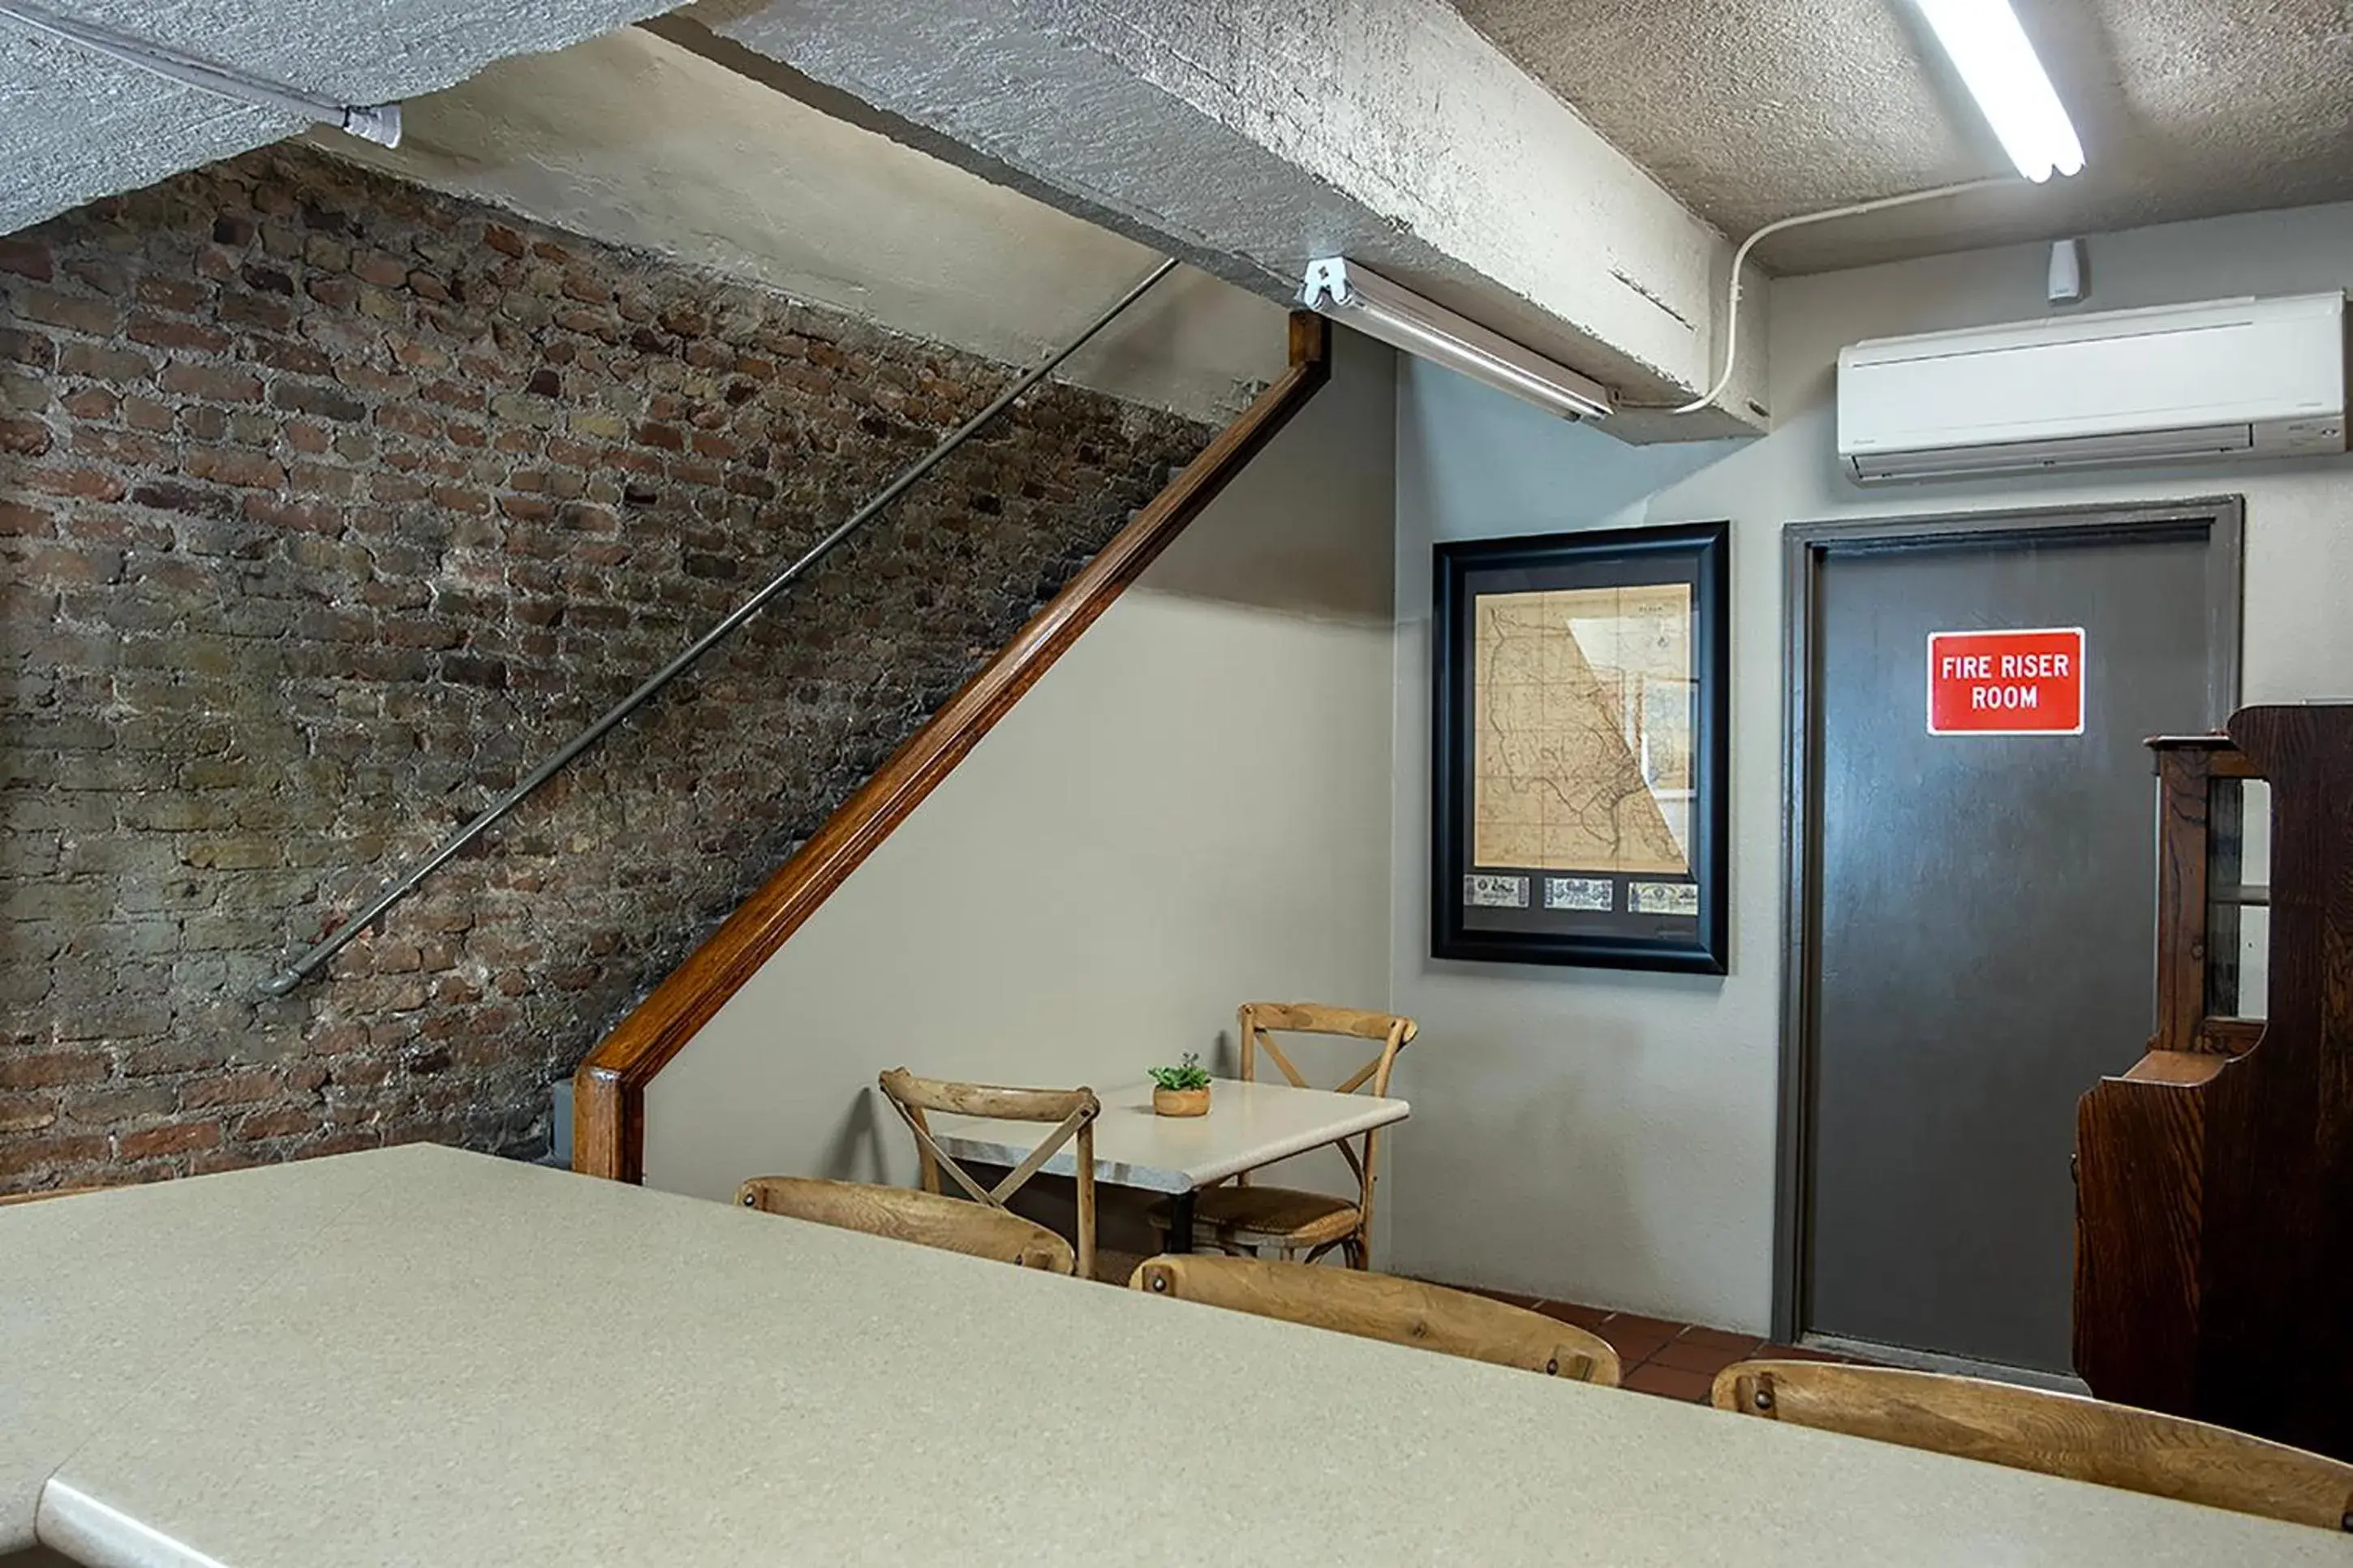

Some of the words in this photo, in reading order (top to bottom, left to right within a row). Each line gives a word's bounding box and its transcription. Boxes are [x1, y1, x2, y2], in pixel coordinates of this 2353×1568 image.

[1942, 655, 1992, 679] FIRE
[2002, 654, 2069, 678] RISER
[1972, 685, 2037, 709] ROOM
